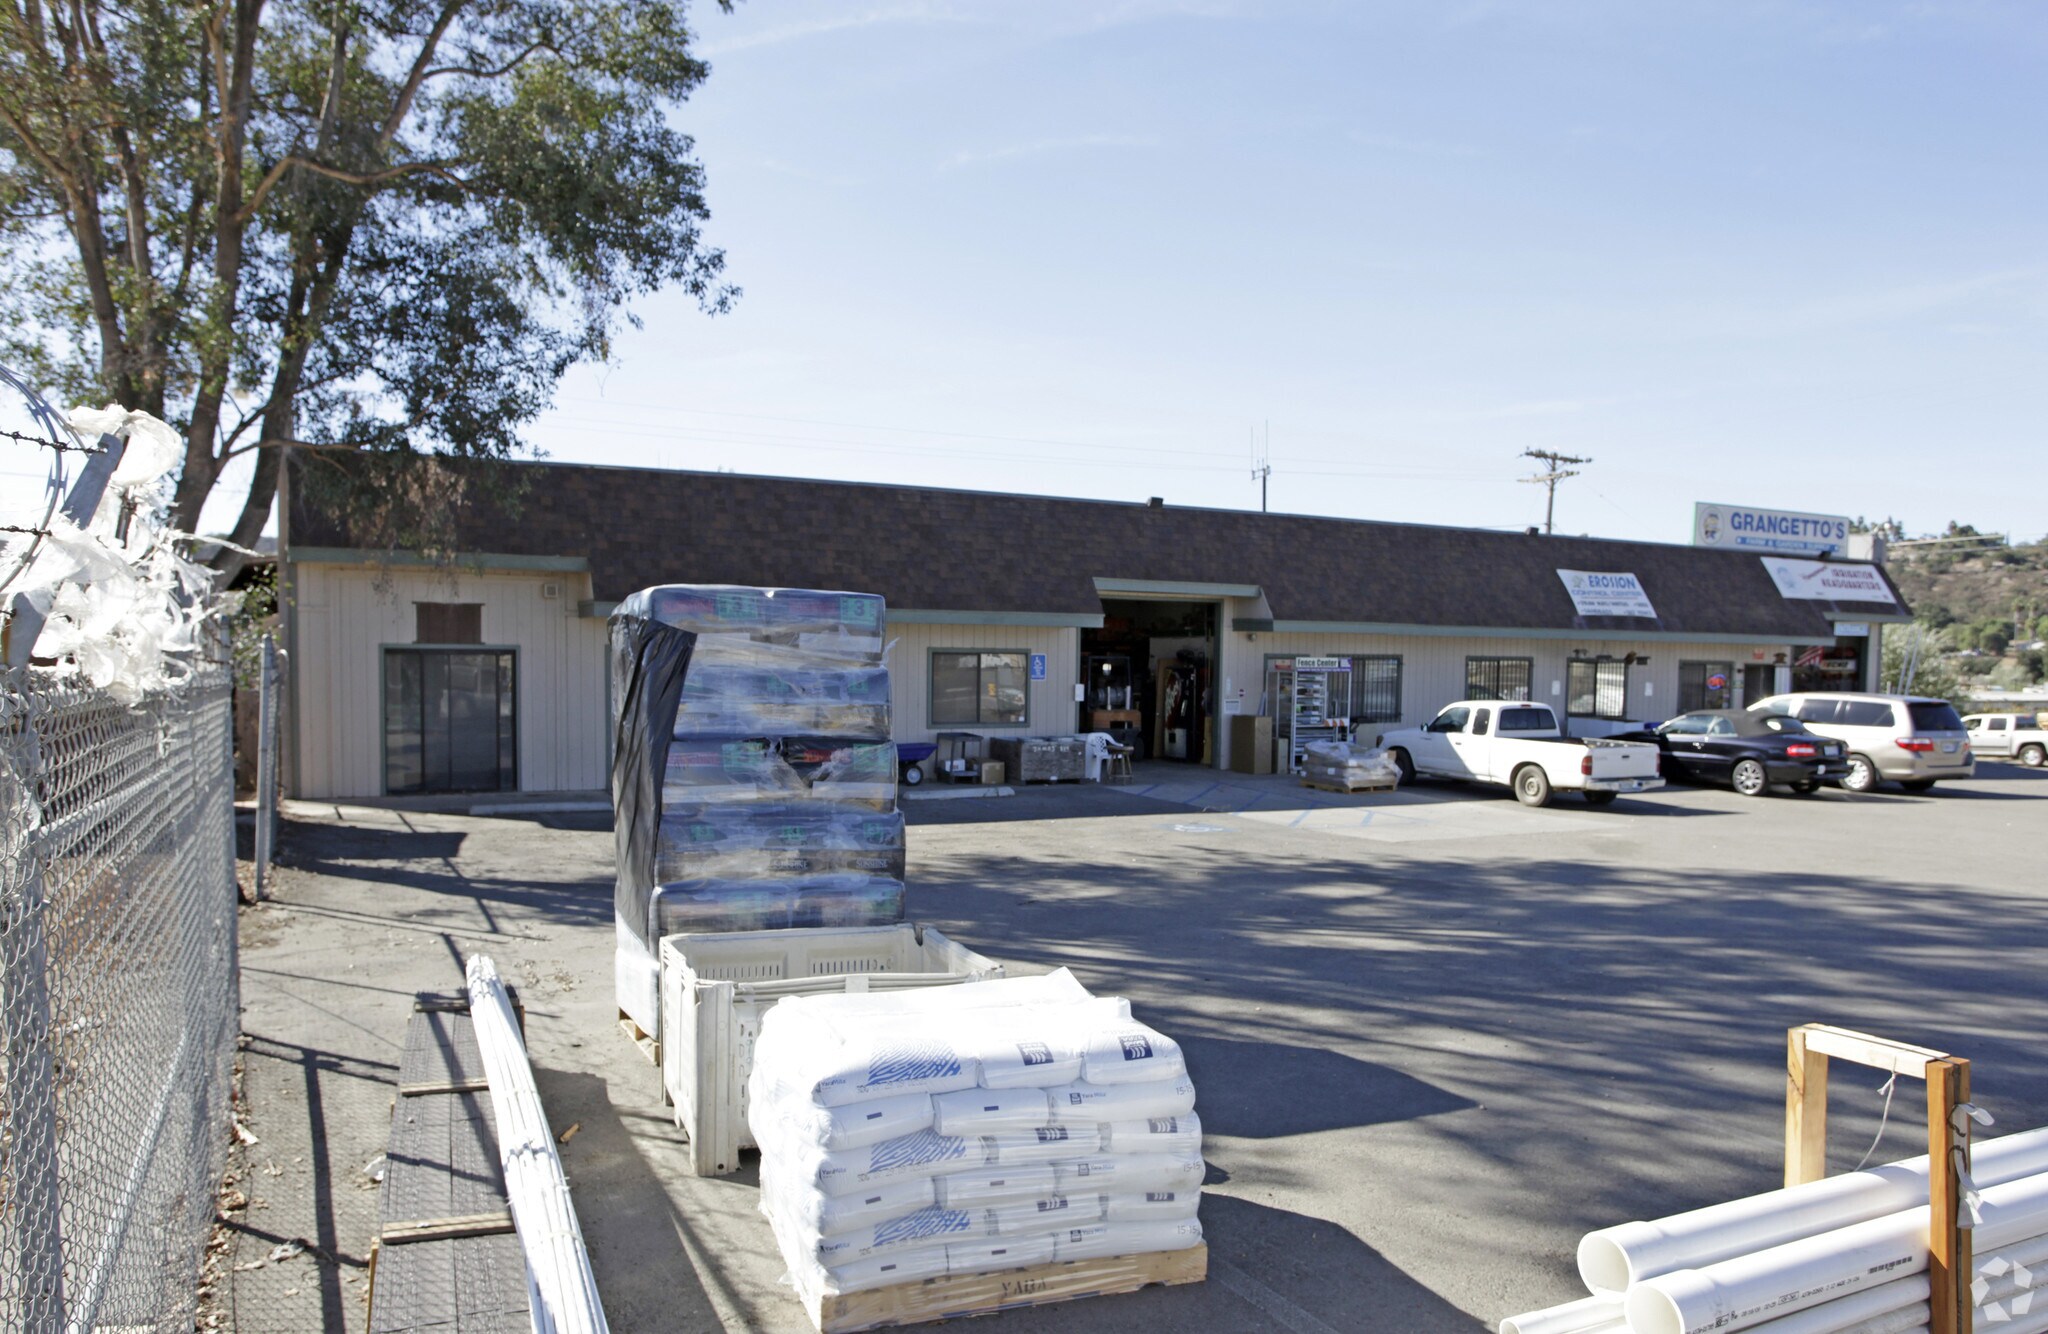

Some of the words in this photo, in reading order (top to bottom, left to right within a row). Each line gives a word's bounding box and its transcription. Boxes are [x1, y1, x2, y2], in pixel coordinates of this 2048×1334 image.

[1731, 512, 1845, 540] GRANGETTO'S
[1745, 536, 1766, 546] FARM
[1775, 540, 1805, 549] GARDEN
[1588, 574, 1636, 589] EROSION
[1821, 579, 1882, 591] HEADQUARTERS
[1571, 589, 1607, 597] CONTROL
[854, 600, 864, 616] 3
[1297, 658, 1316, 667] Fence
[1316, 658, 1337, 667] Center
